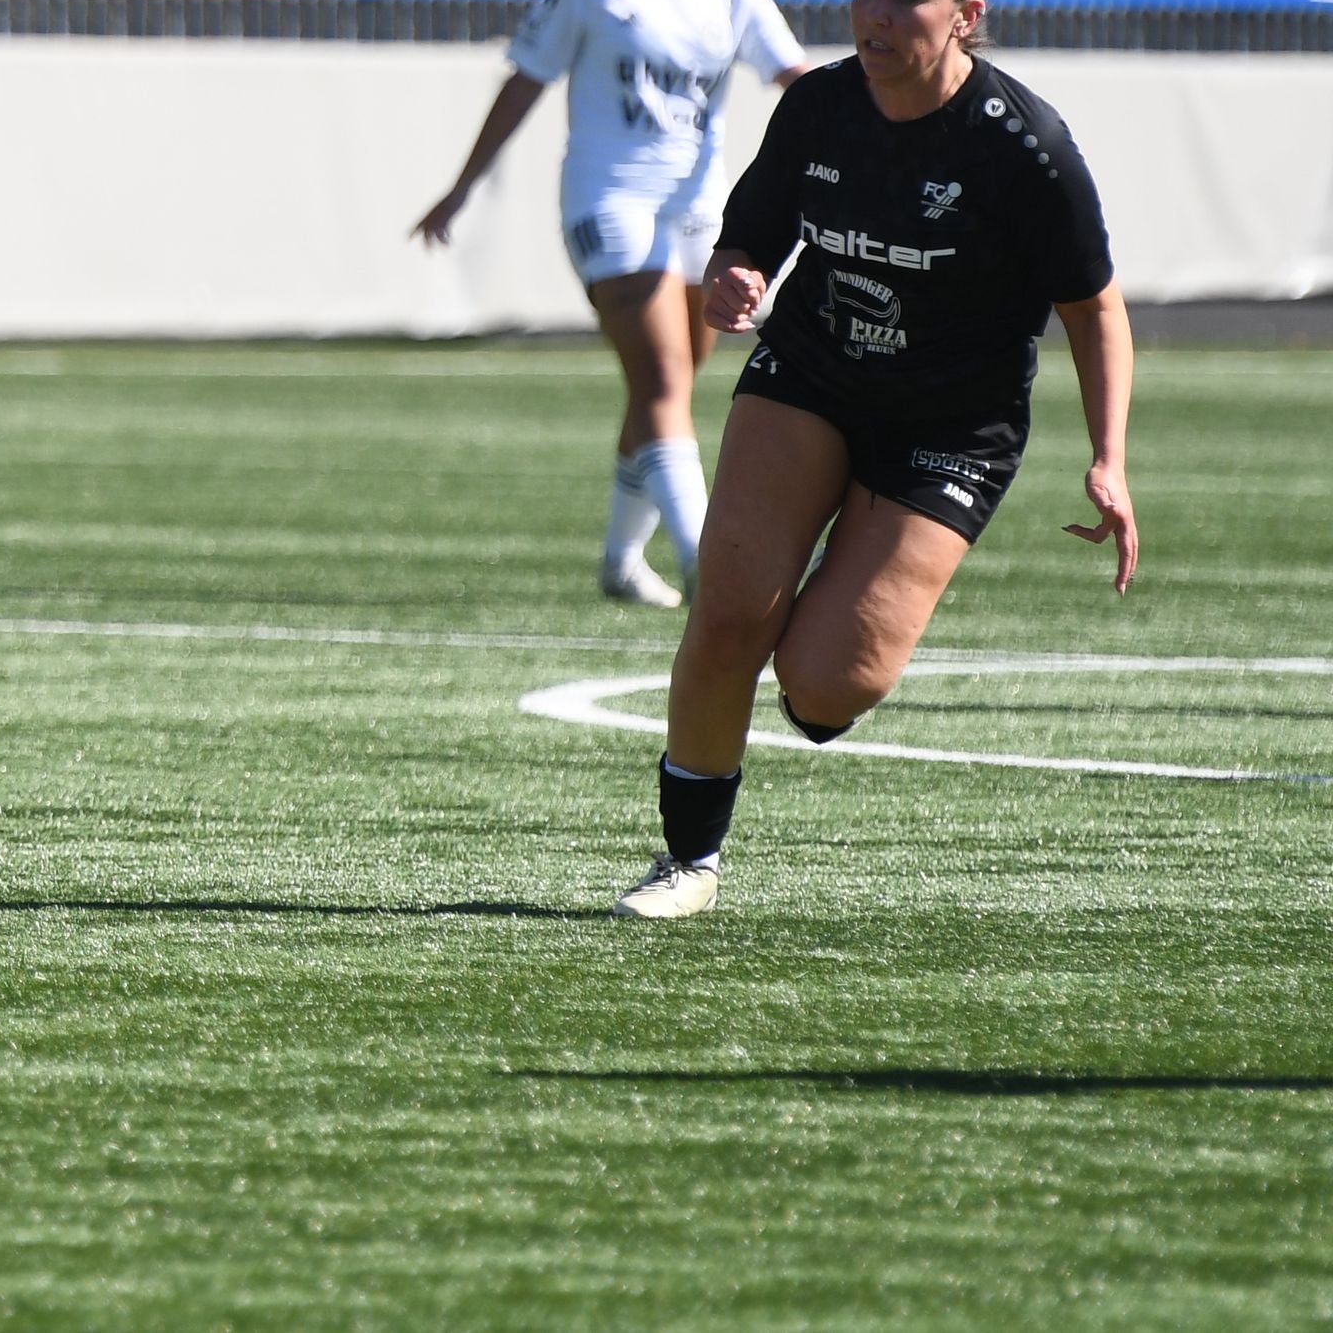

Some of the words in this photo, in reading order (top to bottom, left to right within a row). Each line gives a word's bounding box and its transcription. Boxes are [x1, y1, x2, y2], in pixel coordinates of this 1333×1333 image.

[805, 162, 840, 184] JAKO
[800, 211, 956, 271] halter
[850, 317, 908, 348] PIZZA
[942, 482, 975, 508] JAKO
